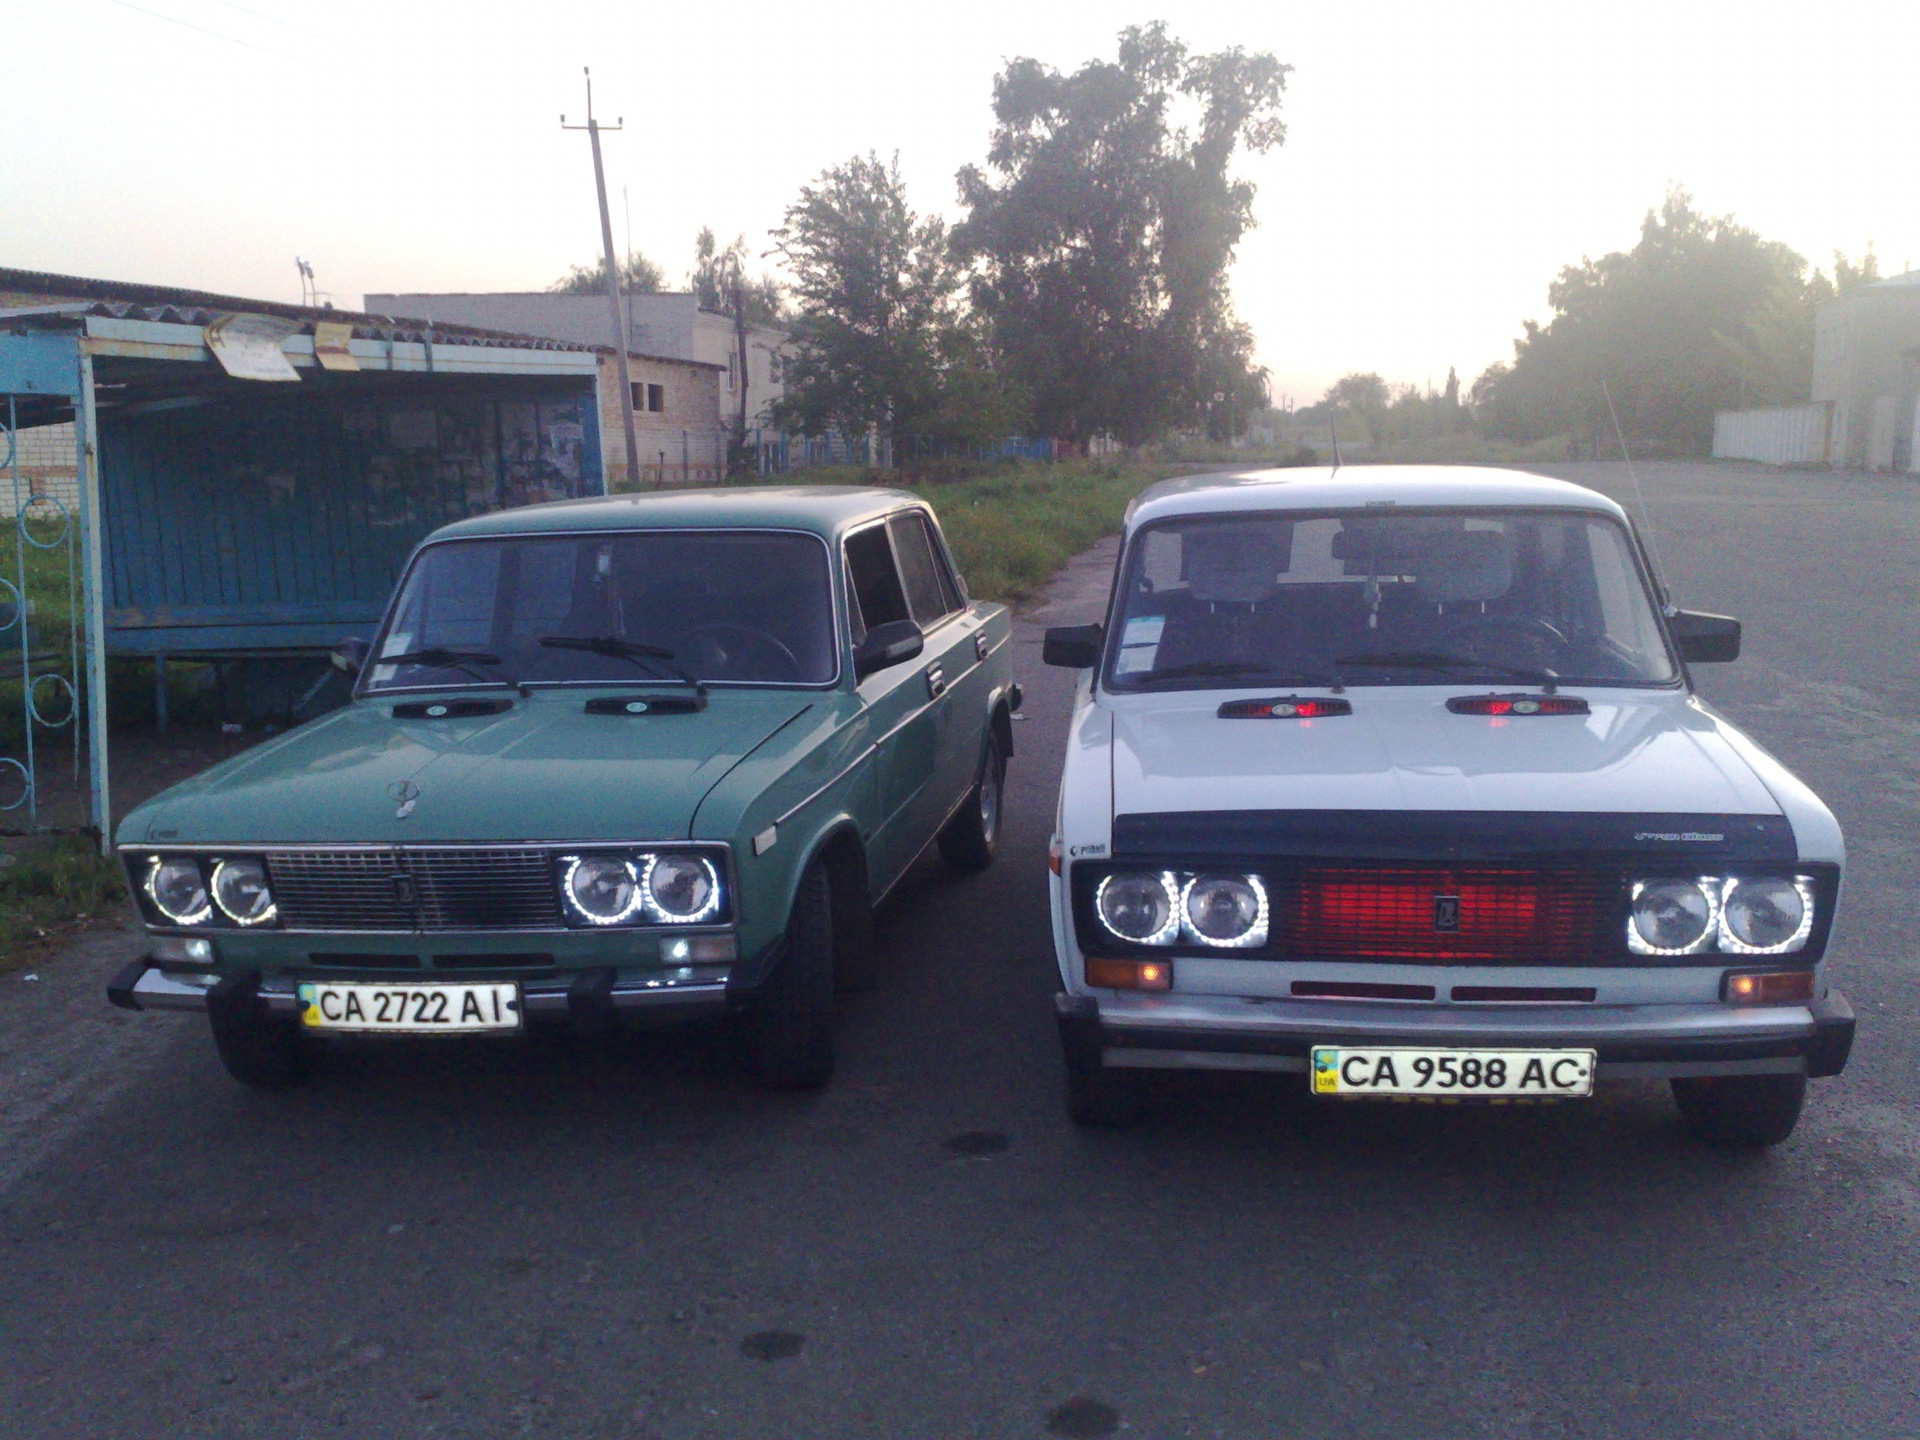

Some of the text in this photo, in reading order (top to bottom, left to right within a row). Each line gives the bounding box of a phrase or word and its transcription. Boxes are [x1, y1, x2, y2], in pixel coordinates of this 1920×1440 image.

[320, 989, 501, 1023] CA 2722 AI
[1319, 1078, 1336, 1087] UA
[1341, 1056, 1579, 1089] CA 9588 AC
